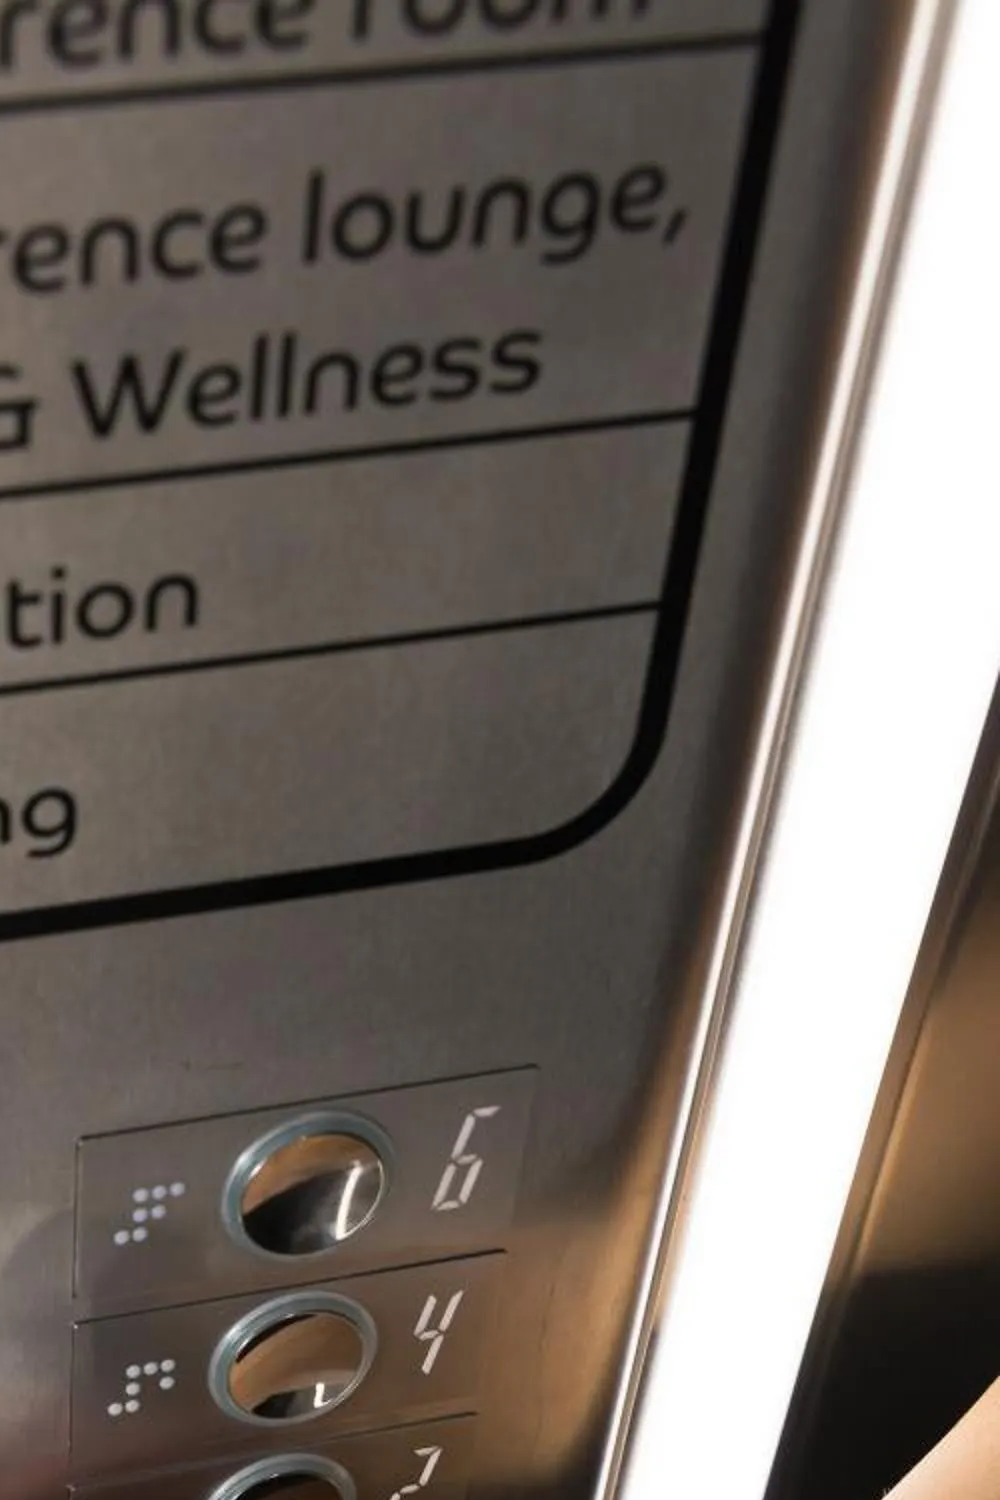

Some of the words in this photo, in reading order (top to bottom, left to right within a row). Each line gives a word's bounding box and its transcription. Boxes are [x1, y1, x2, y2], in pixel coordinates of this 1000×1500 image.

[300, 168, 689, 268] lounge,
[73, 330, 543, 440] Wellness
[431, 1105, 500, 1211] 6
[414, 1290, 464, 1375] 4
